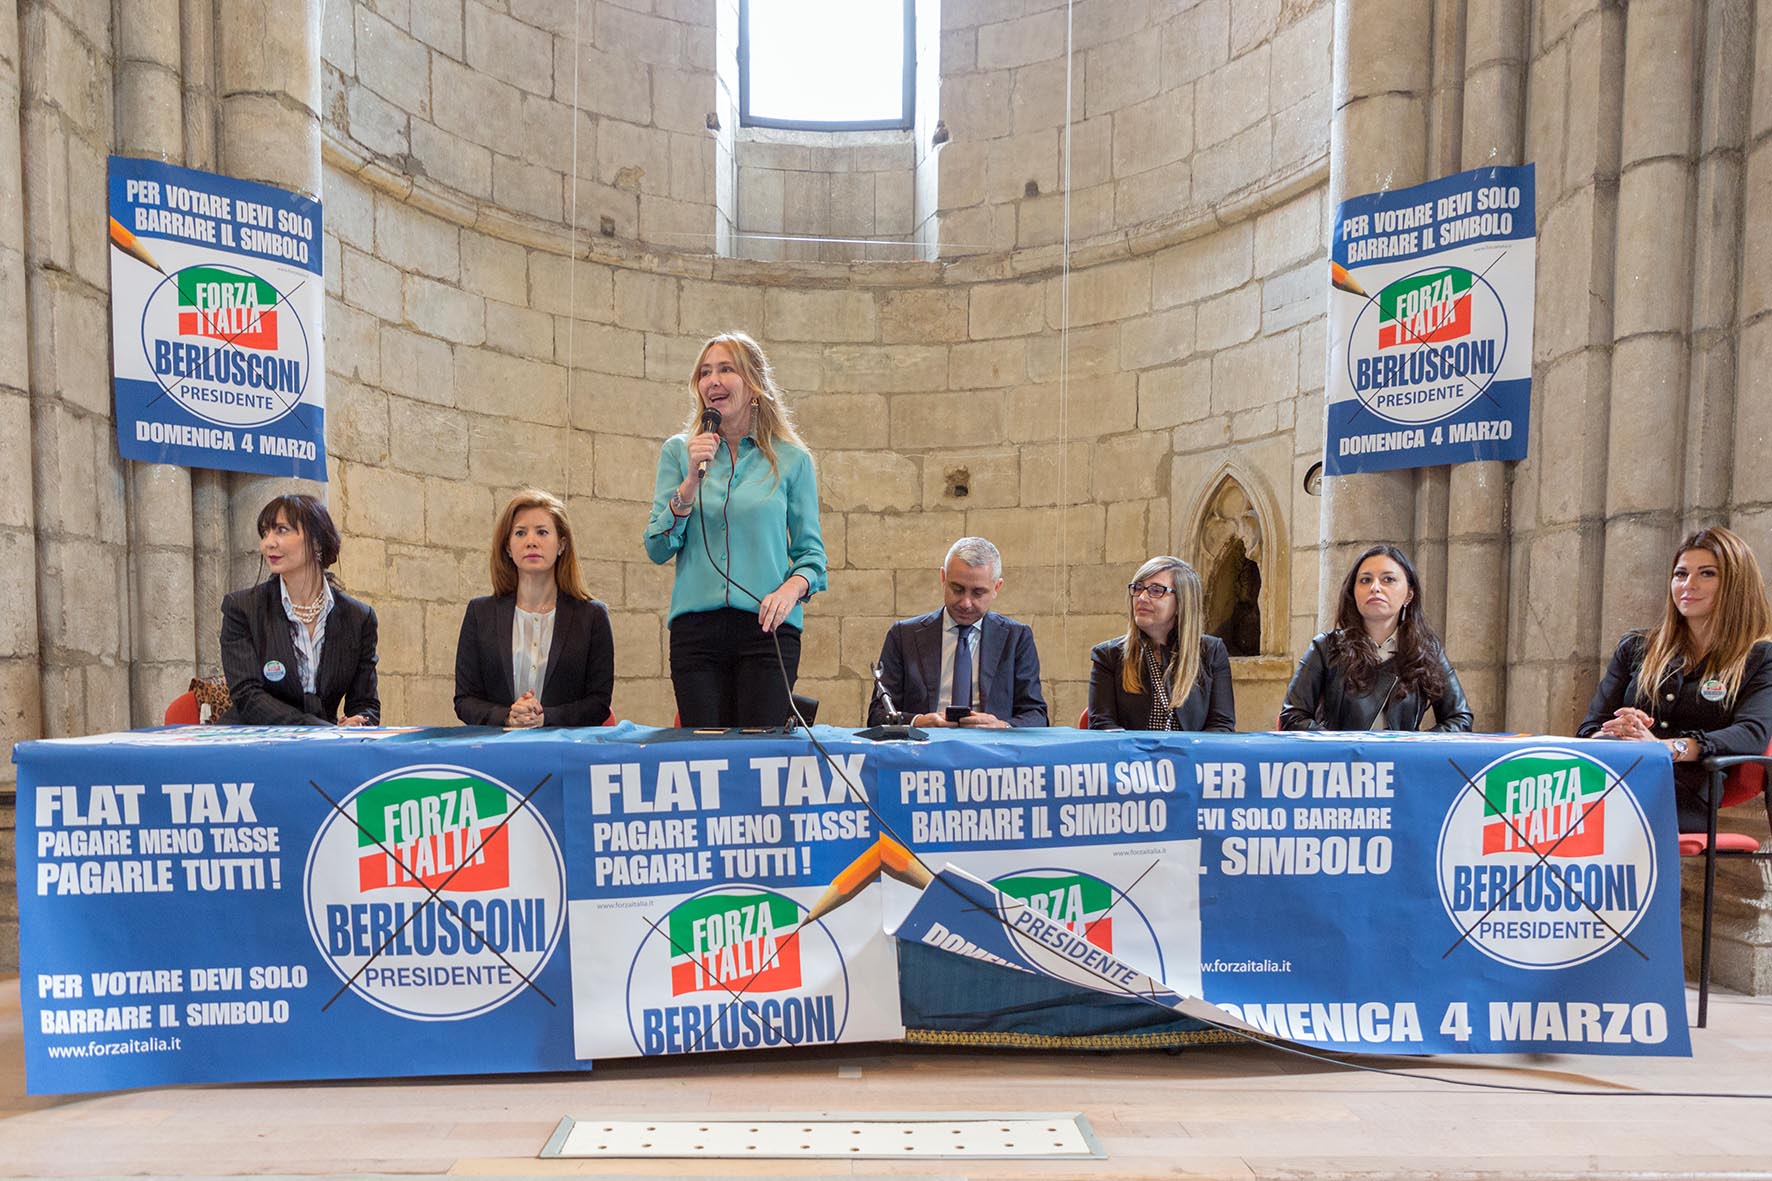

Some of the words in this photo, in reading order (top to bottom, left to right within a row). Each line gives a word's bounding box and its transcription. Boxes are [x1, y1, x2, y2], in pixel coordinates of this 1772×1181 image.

[126, 180, 160, 206] PER
[165, 184, 231, 220] VOTARE
[236, 199, 273, 226] DEVI
[278, 209, 313, 240] SOLO
[1343, 214, 1369, 241] PER
[1374, 200, 1432, 232] VOTARE
[1437, 191, 1473, 219] DEVI
[1477, 187, 1520, 210] SOLO
[135, 207, 216, 241] BARRARE
[222, 225, 235, 247] IL
[240, 230, 308, 264] SIMBOLO
[1347, 232, 1417, 264] BARRARE
[1423, 230, 1436, 249] IL
[1440, 213, 1513, 244] SIMBOLO
[196, 282, 258, 309] FORZA
[1396, 275, 1454, 318] FORZA
[197, 306, 262, 335] ITALIA
[1396, 299, 1456, 344] ITALIA
[154, 339, 300, 394] BERLUSCONI
[1357, 339, 1495, 392] BERLUSCONI
[180, 385, 273, 410] PRESIDENTE
[1377, 383, 1464, 408] PRESIDENTE
[136, 420, 235, 451] DOMENICA
[241, 433, 254, 453] 4
[260, 435, 316, 461] MARZO
[1339, 429, 1425, 457] DOMENICA
[1431, 426, 1443, 446] 4
[1449, 420, 1512, 444] MARZO
[590, 758, 729, 815] FLAT
[750, 754, 870, 807] TAX
[900, 770, 947, 805] PER
[953, 766, 1047, 802] VOTARE
[1053, 762, 1108, 798] DEVI
[1114, 758, 1176, 796] SOLO
[1259, 761, 1395, 799] VOTARE
[1506, 766, 1584, 816] FORZA
[35, 785, 145, 827] FLAT
[162, 783, 258, 824] TAX
[384, 786, 479, 843] FORZA
[911, 807, 1024, 844] BARRARE
[1032, 806, 1052, 839] IL
[1059, 798, 1167, 838] SIMBOLO
[1197, 807, 1225, 831] EVI
[1231, 807, 1287, 831] SOLO
[1293, 807, 1392, 830] BARRARE
[1504, 800, 1585, 851] ITALIA
[37, 829, 132, 858] PAGARE
[139, 828, 204, 854] MENO
[210, 827, 281, 853] TASSE
[593, 818, 698, 852] PAGARE
[706, 813, 782, 846] MENO
[789, 810, 871, 842] TASSE
[386, 826, 485, 886] ITALIA
[595, 851, 713, 887] PAGARLE
[1220, 835, 1393, 876] SIMBOLO
[37, 860, 174, 896] PAGARLE
[1453, 864, 1638, 913] BERLUSCONI
[326, 898, 546, 957] BERLUSCONI
[692, 901, 773, 952] FORZA
[1014, 910, 1139, 985] PRESIDENTE
[1480, 921, 1606, 940] PRESIDENTE
[38, 973, 83, 999] PER
[91, 969, 184, 997] VOTARE
[190, 967, 242, 992] DEVI
[249, 965, 308, 989] SOLO
[364, 965, 512, 988] PRESIDENTE
[694, 934, 780, 990] ITALIA
[1200, 959, 1292, 973] w.forzaitalia.it
[40, 1005, 152, 1035] BARRARE
[159, 1004, 180, 1028] IL
[186, 1000, 289, 1026] SIMBOLO
[643, 995, 836, 1056] BERLUSCONI
[1439, 1002, 1472, 1042] 4
[1488, 1001, 1668, 1045] MARZO
[48, 1036, 182, 1059] www.forzaitalia.it
